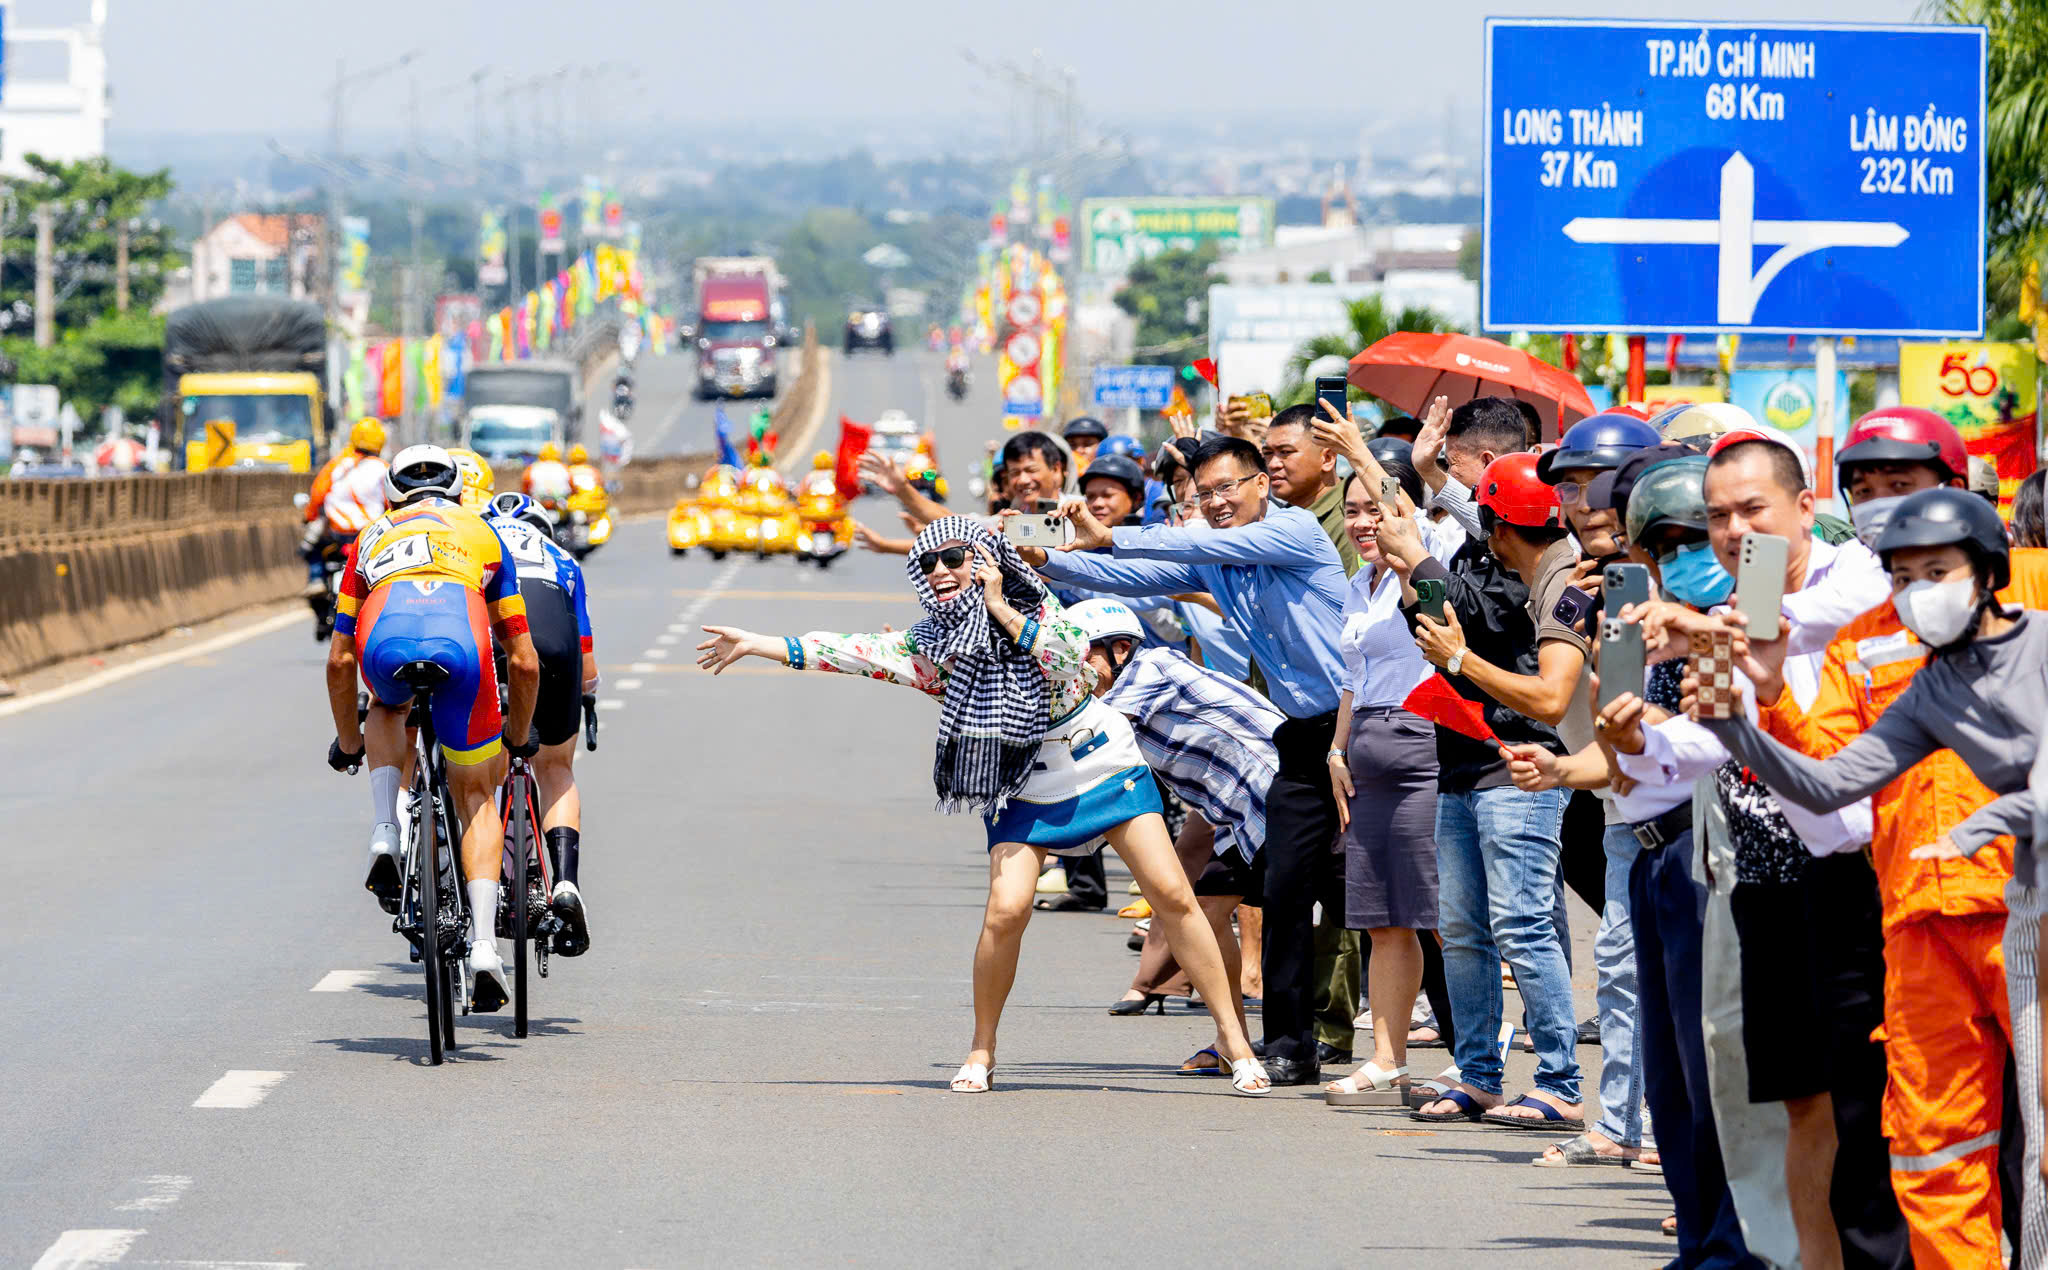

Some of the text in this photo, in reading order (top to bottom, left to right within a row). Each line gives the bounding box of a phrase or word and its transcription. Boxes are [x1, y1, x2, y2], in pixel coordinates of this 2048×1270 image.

[1647, 29, 1815, 78] TP.HỒ CHÍ MINH
[1705, 83, 1785, 121] 68 Km
[1503, 101, 1643, 147] LONG THÀNH
[1850, 103, 1967, 153] LÂM ĐỒNG
[1540, 150, 1617, 188] 37 Km
[1860, 157, 1954, 194] 232 Km
[1939, 352, 1998, 397] 50
[373, 540, 415, 570] 27
